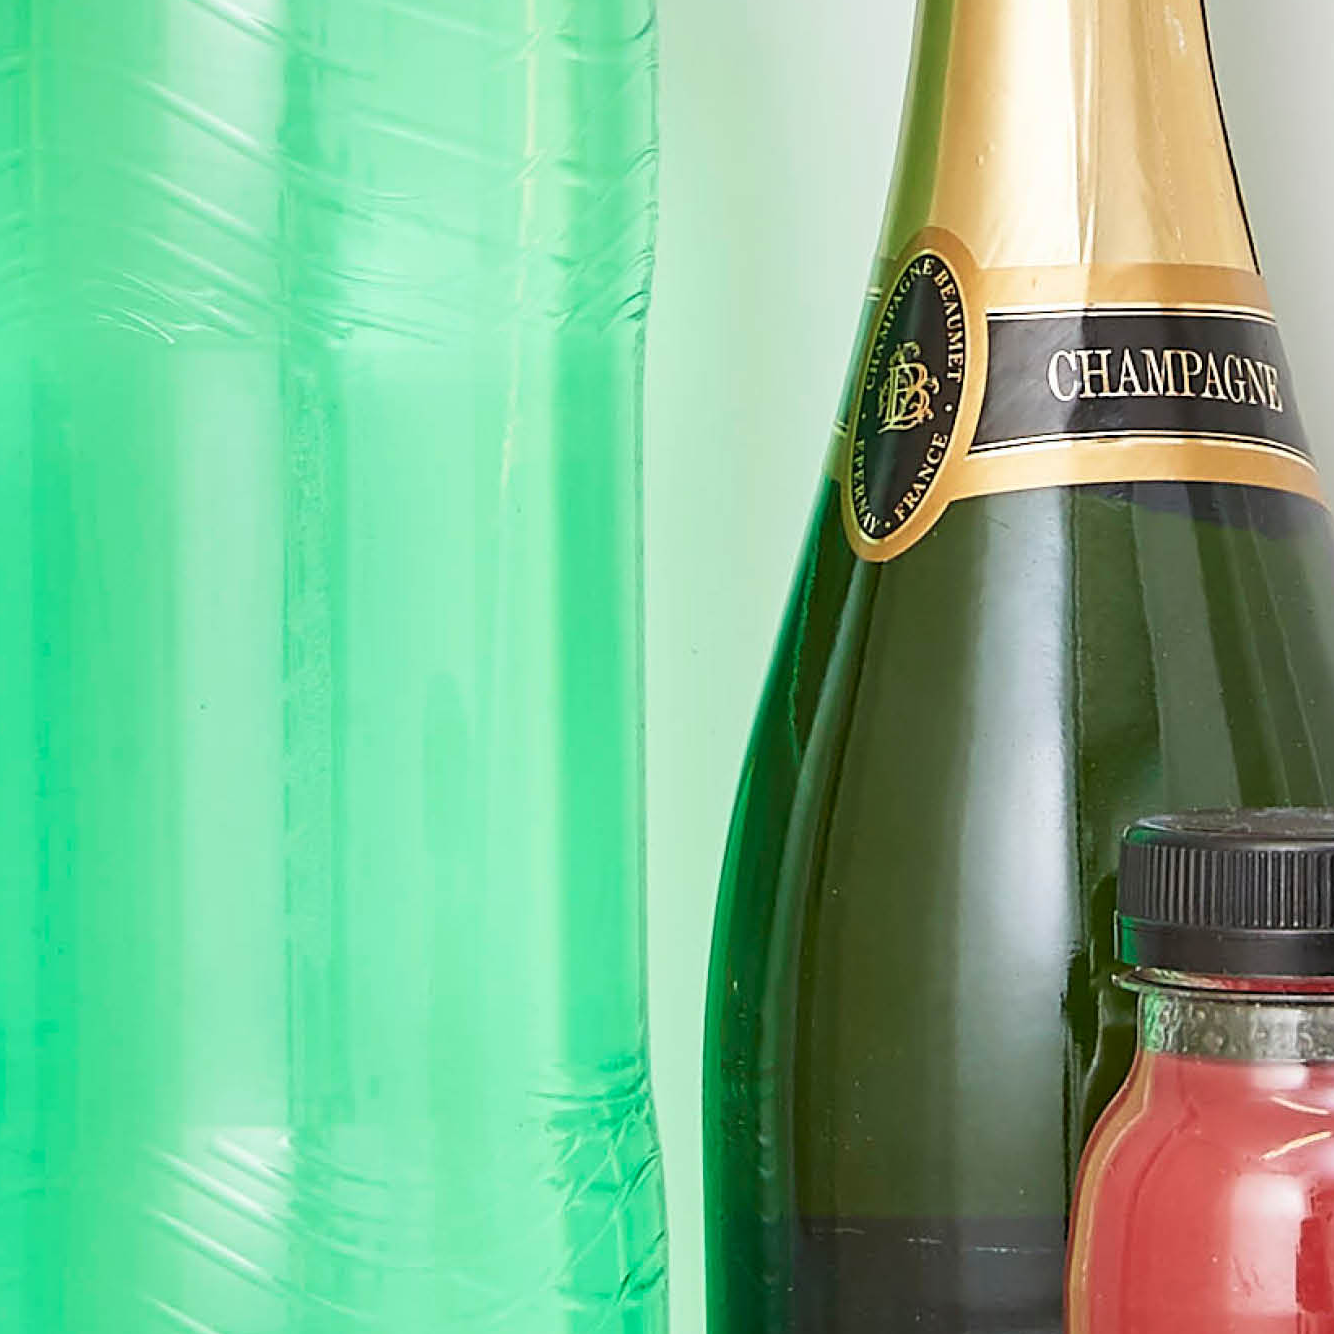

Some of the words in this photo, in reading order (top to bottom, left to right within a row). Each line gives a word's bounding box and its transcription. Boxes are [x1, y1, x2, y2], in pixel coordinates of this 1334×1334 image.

[865, 258, 934, 391] CHAMPAGNE
[933, 271, 964, 383] BEAUMET
[1048, 348, 1284, 413] CHAMPAGNE
[893, 432, 948, 522] FRANCE
